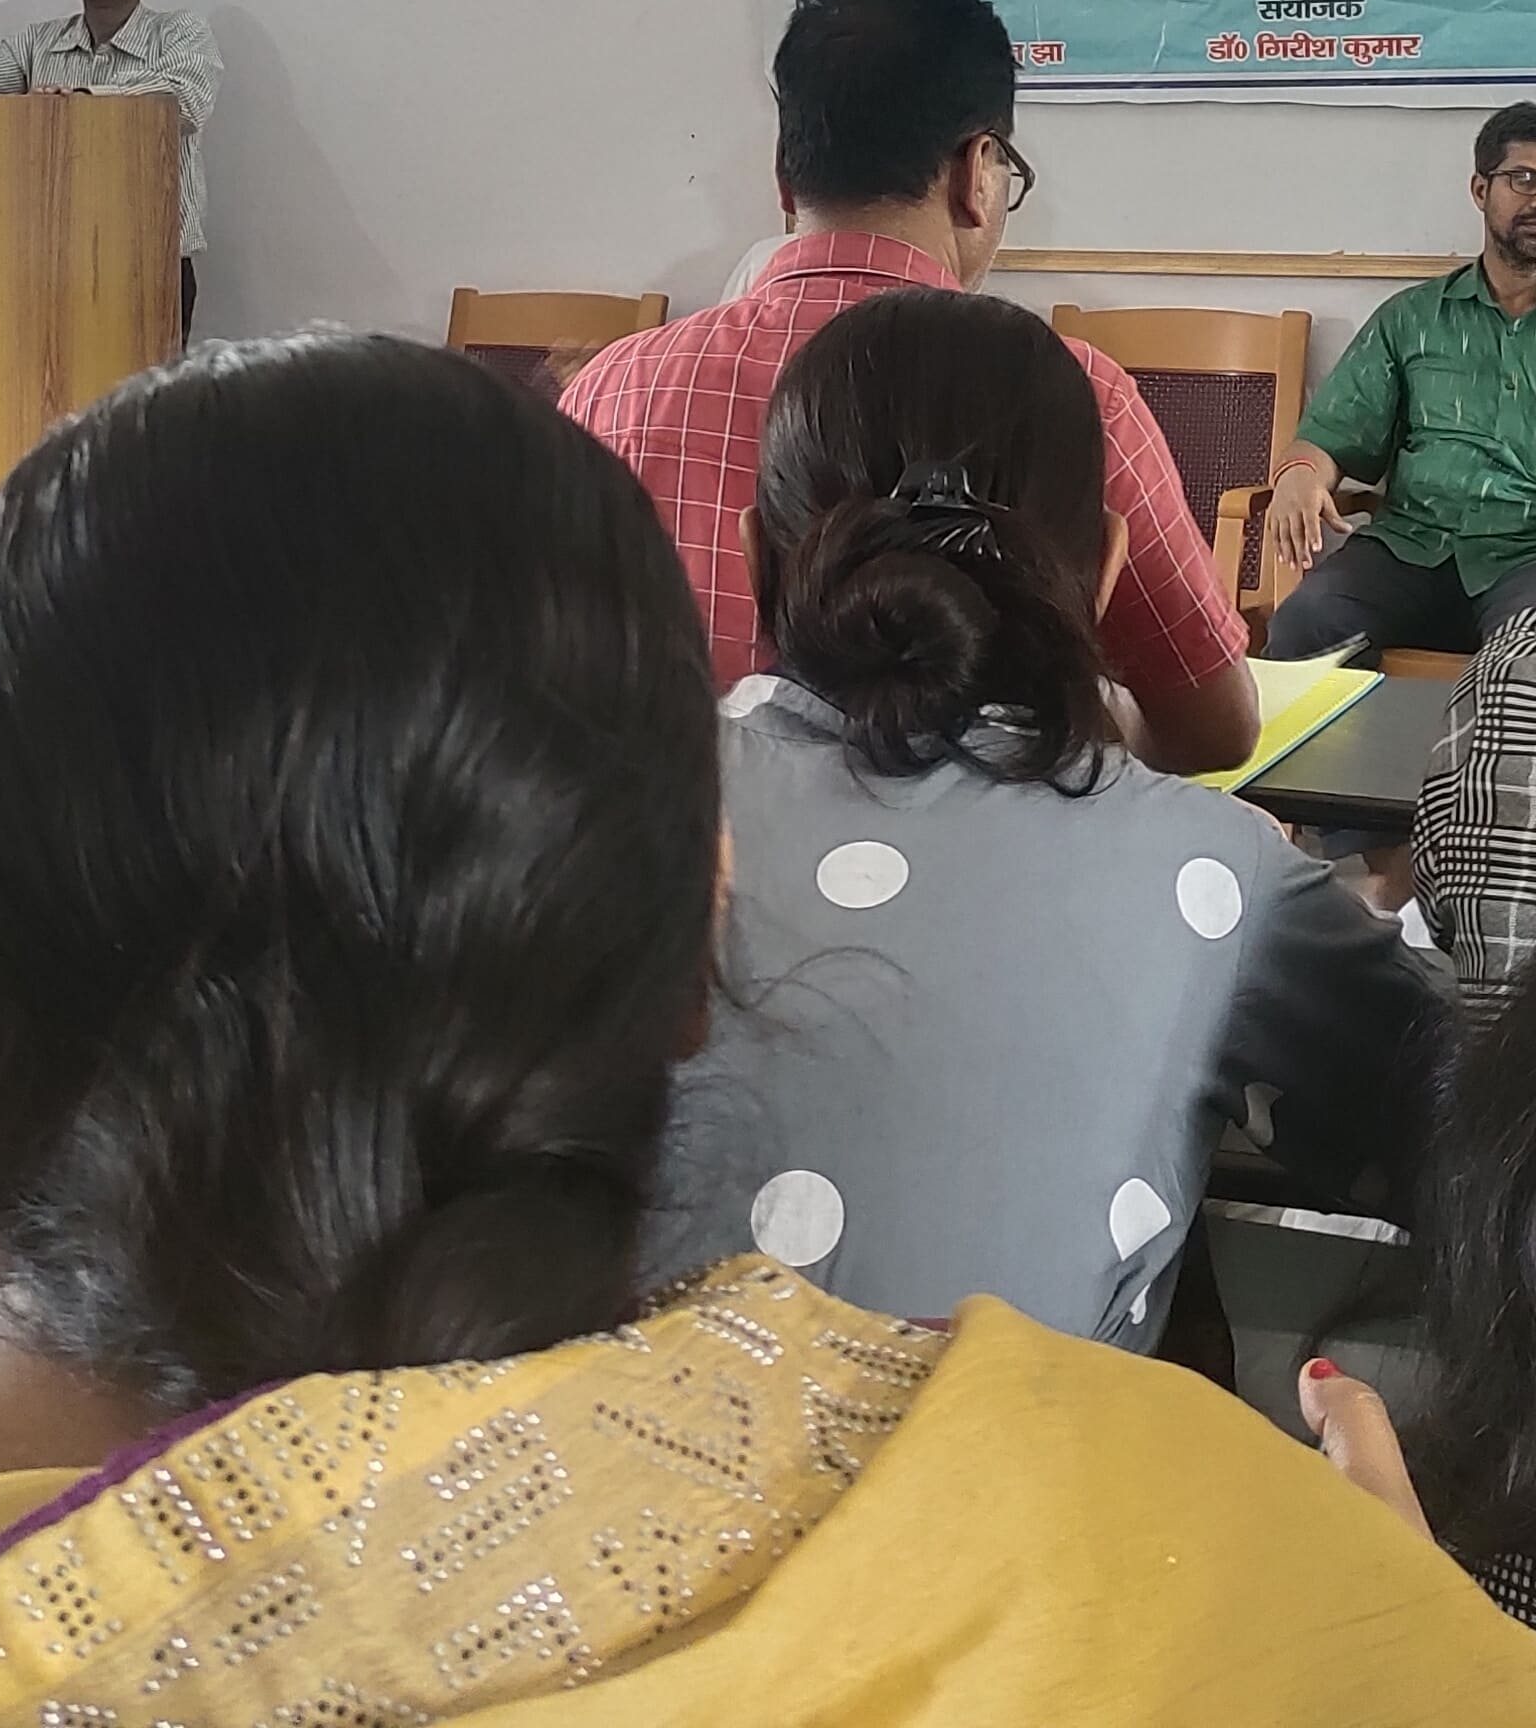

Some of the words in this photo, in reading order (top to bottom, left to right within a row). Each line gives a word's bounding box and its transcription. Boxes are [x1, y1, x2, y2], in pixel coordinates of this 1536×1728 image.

[1029, 42, 1065, 65] झा
[1257, 32, 1337, 59] गिरीश
[1343, 35, 1422, 66] कुमार
